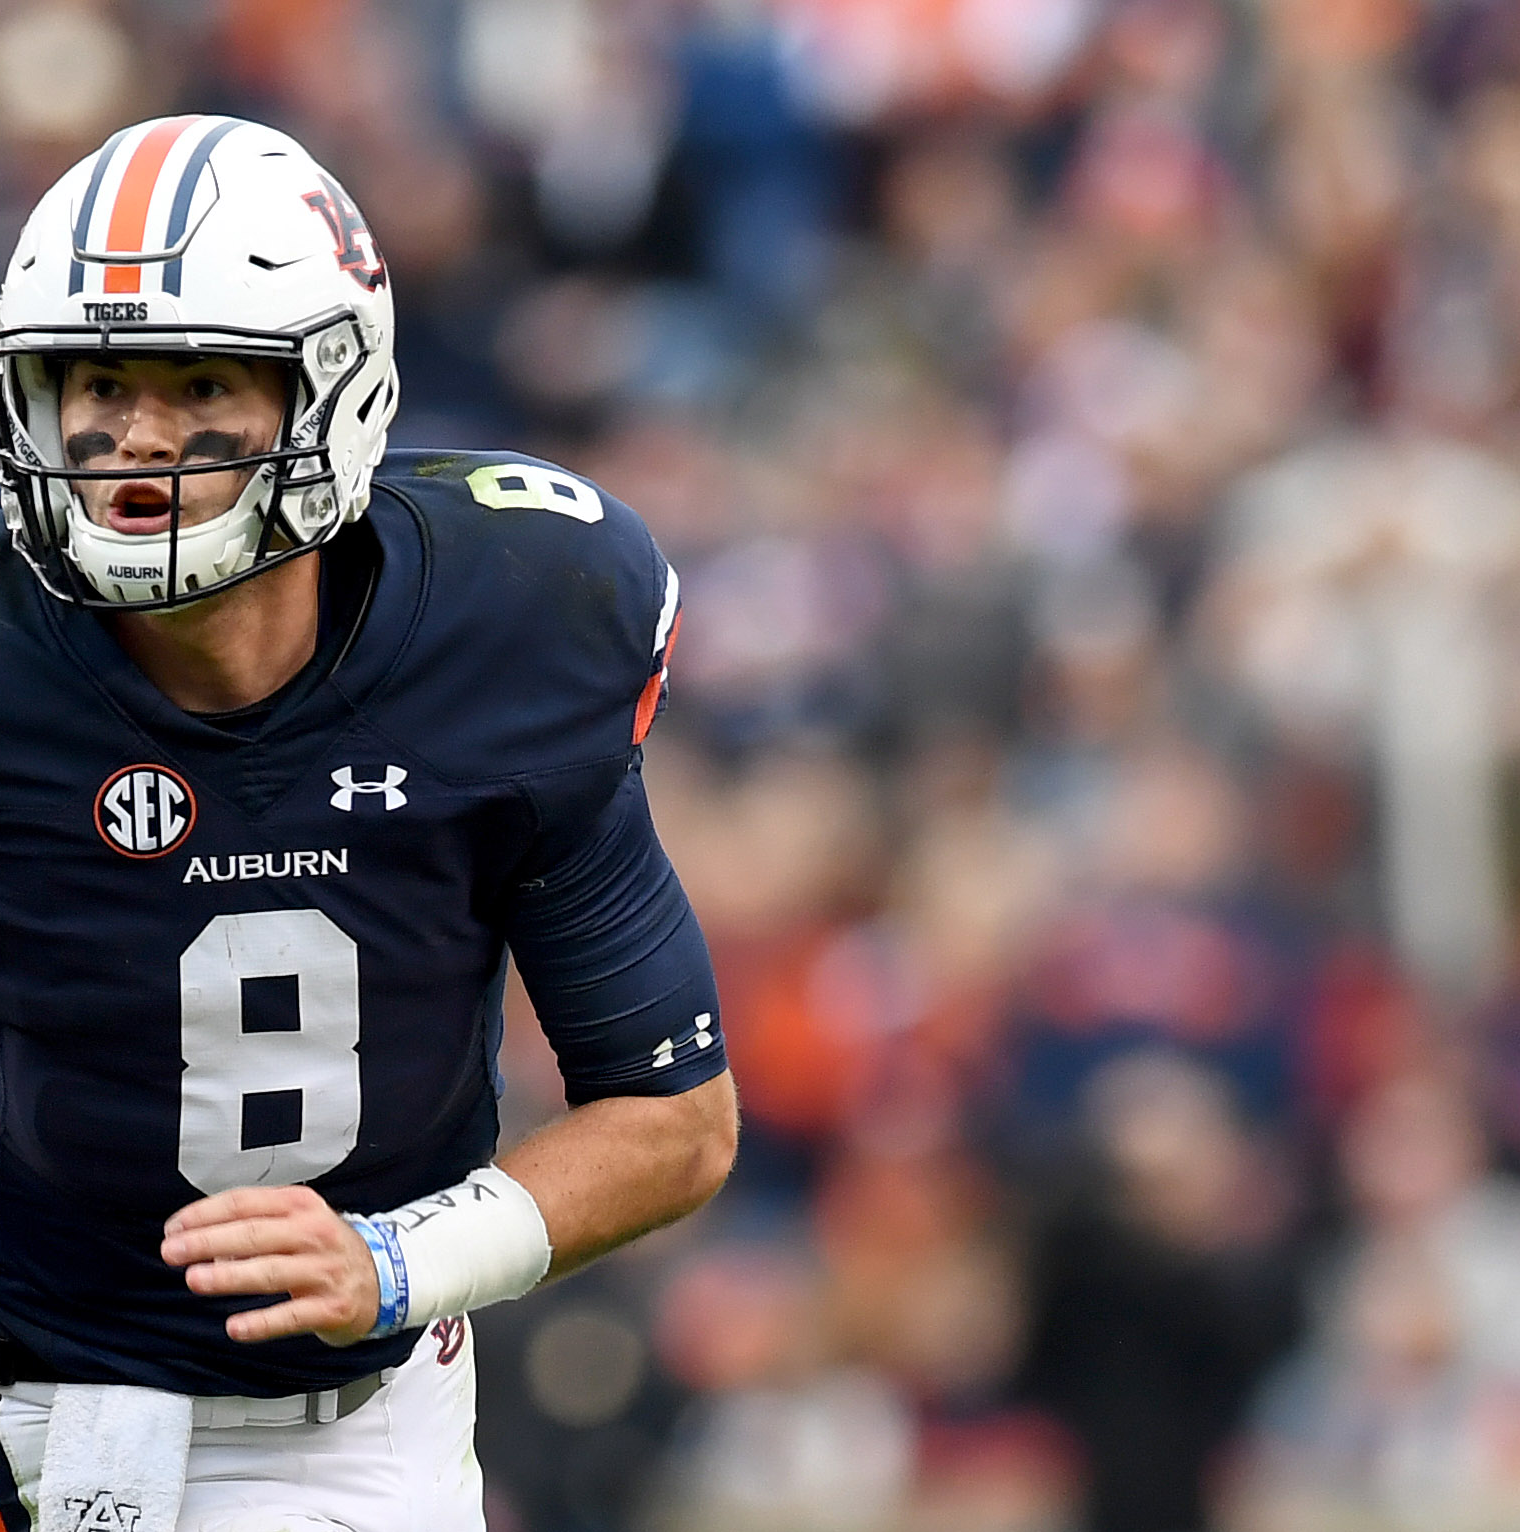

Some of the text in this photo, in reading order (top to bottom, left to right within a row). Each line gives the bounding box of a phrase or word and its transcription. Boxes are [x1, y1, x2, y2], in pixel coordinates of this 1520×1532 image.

[82, 302, 148, 322] TIGERS
[465, 463, 604, 524] 8
[106, 565, 164, 579] AUBURN
[103, 771, 186, 851] SEC
[182, 848, 349, 884] AUBURN
[178, 909, 361, 1197] 8
